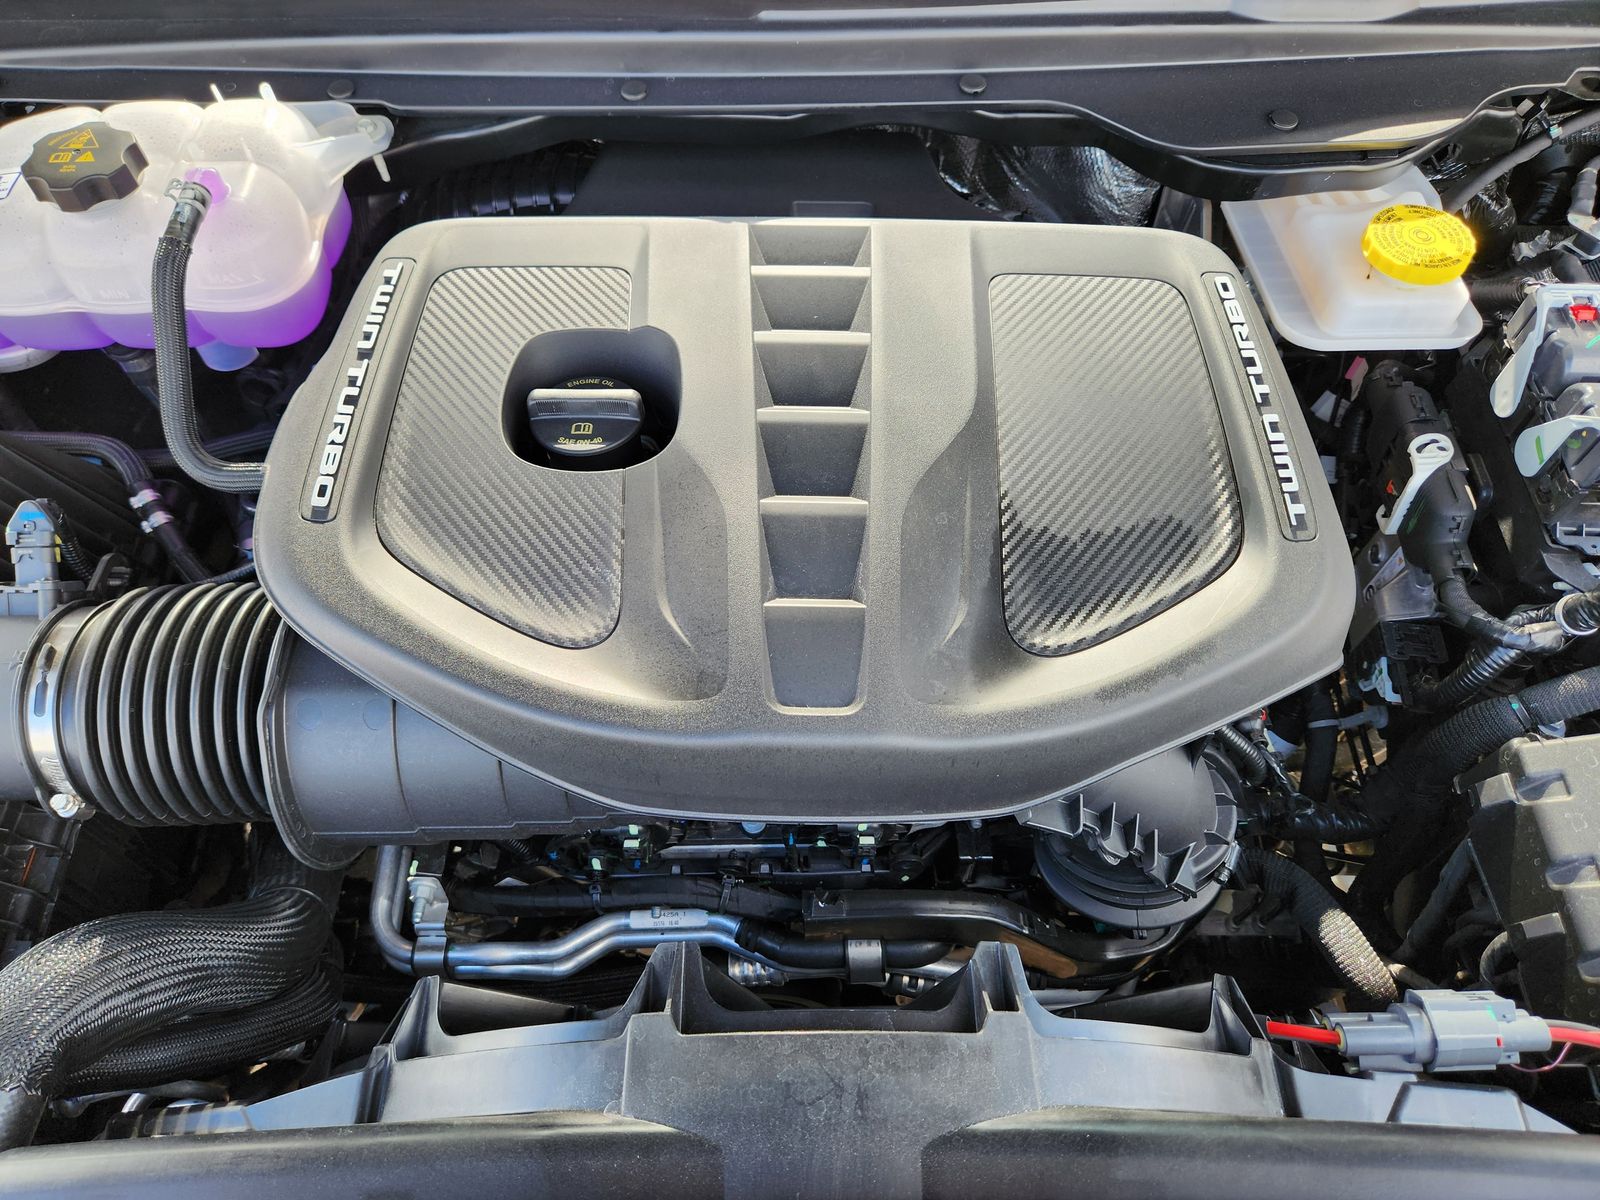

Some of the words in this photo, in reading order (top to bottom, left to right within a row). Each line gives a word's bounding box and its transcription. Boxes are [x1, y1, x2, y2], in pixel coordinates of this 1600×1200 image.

[357, 262, 404, 349] TWIN
[1214, 276, 1270, 404] TURBO
[310, 359, 369, 507] TURBO
[566, 378, 601, 388] ENGINE
[601, 379, 615, 388] OIL
[557, 436, 576, 445] SAE
[1262, 413, 1306, 526] TWIN
